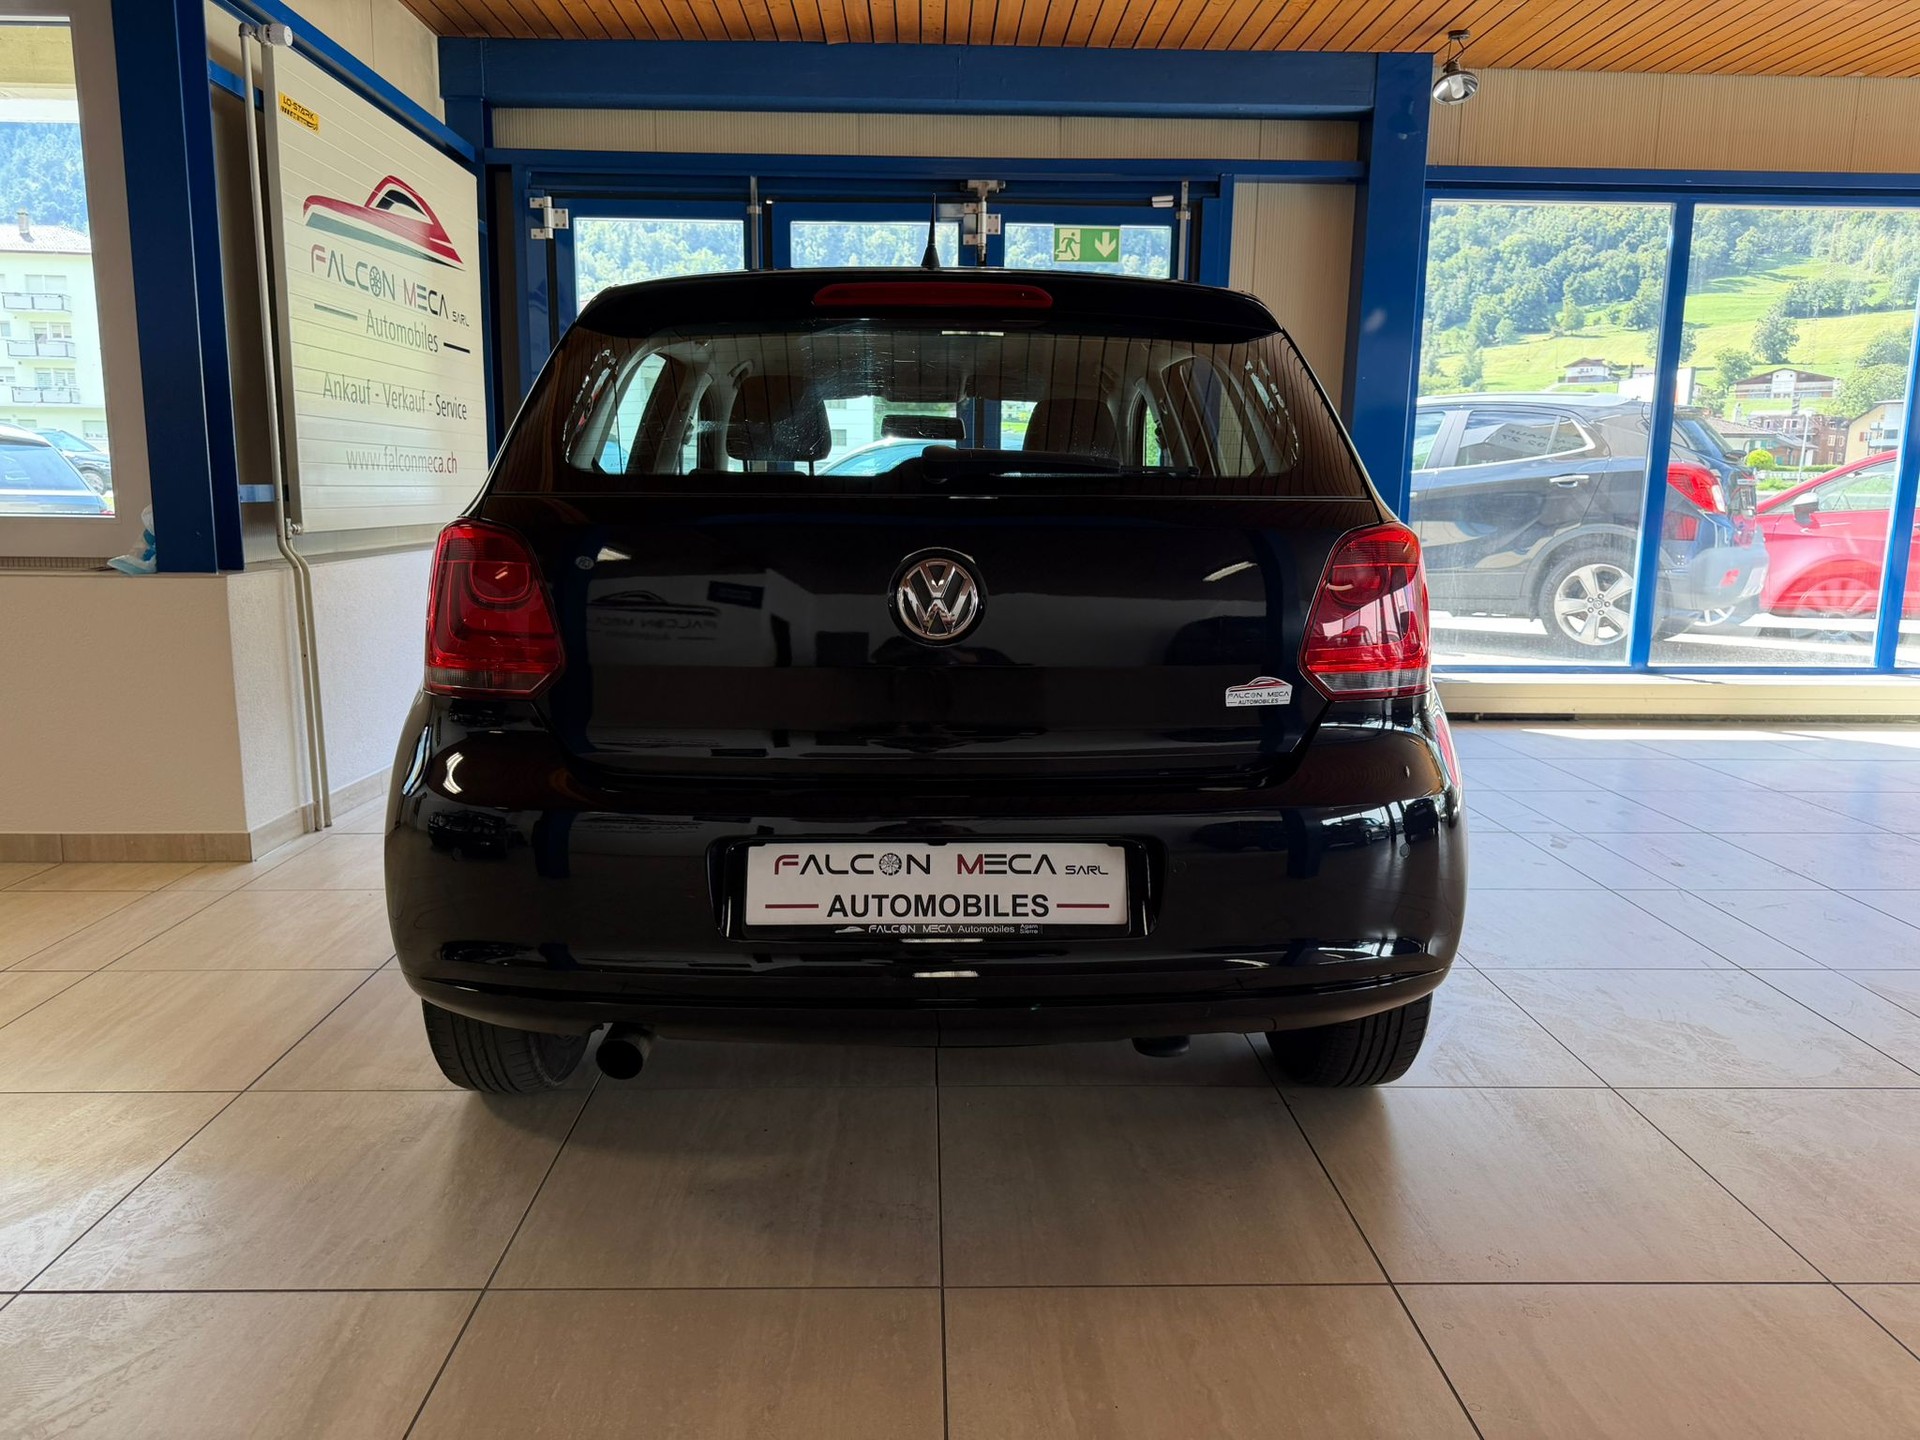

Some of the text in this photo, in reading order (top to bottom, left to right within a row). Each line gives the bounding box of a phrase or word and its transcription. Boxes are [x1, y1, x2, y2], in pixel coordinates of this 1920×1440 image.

[311, 244, 470, 327] FALCON MECA SARL
[366, 308, 439, 353] Automobiles
[323, 372, 371, 405] Ankauf
[383, 382, 426, 413] Verkauf
[435, 394, 467, 420] Service
[346, 446, 458, 474] www.falconmeca.ch
[774, 852, 1110, 876] FALCON MECA SARL
[826, 894, 1050, 918] AUTOMOBILES
[868, 924, 916, 934] FALCON
[922, 924, 953, 934] MECA
[957, 924, 1015, 934] Automobiles
